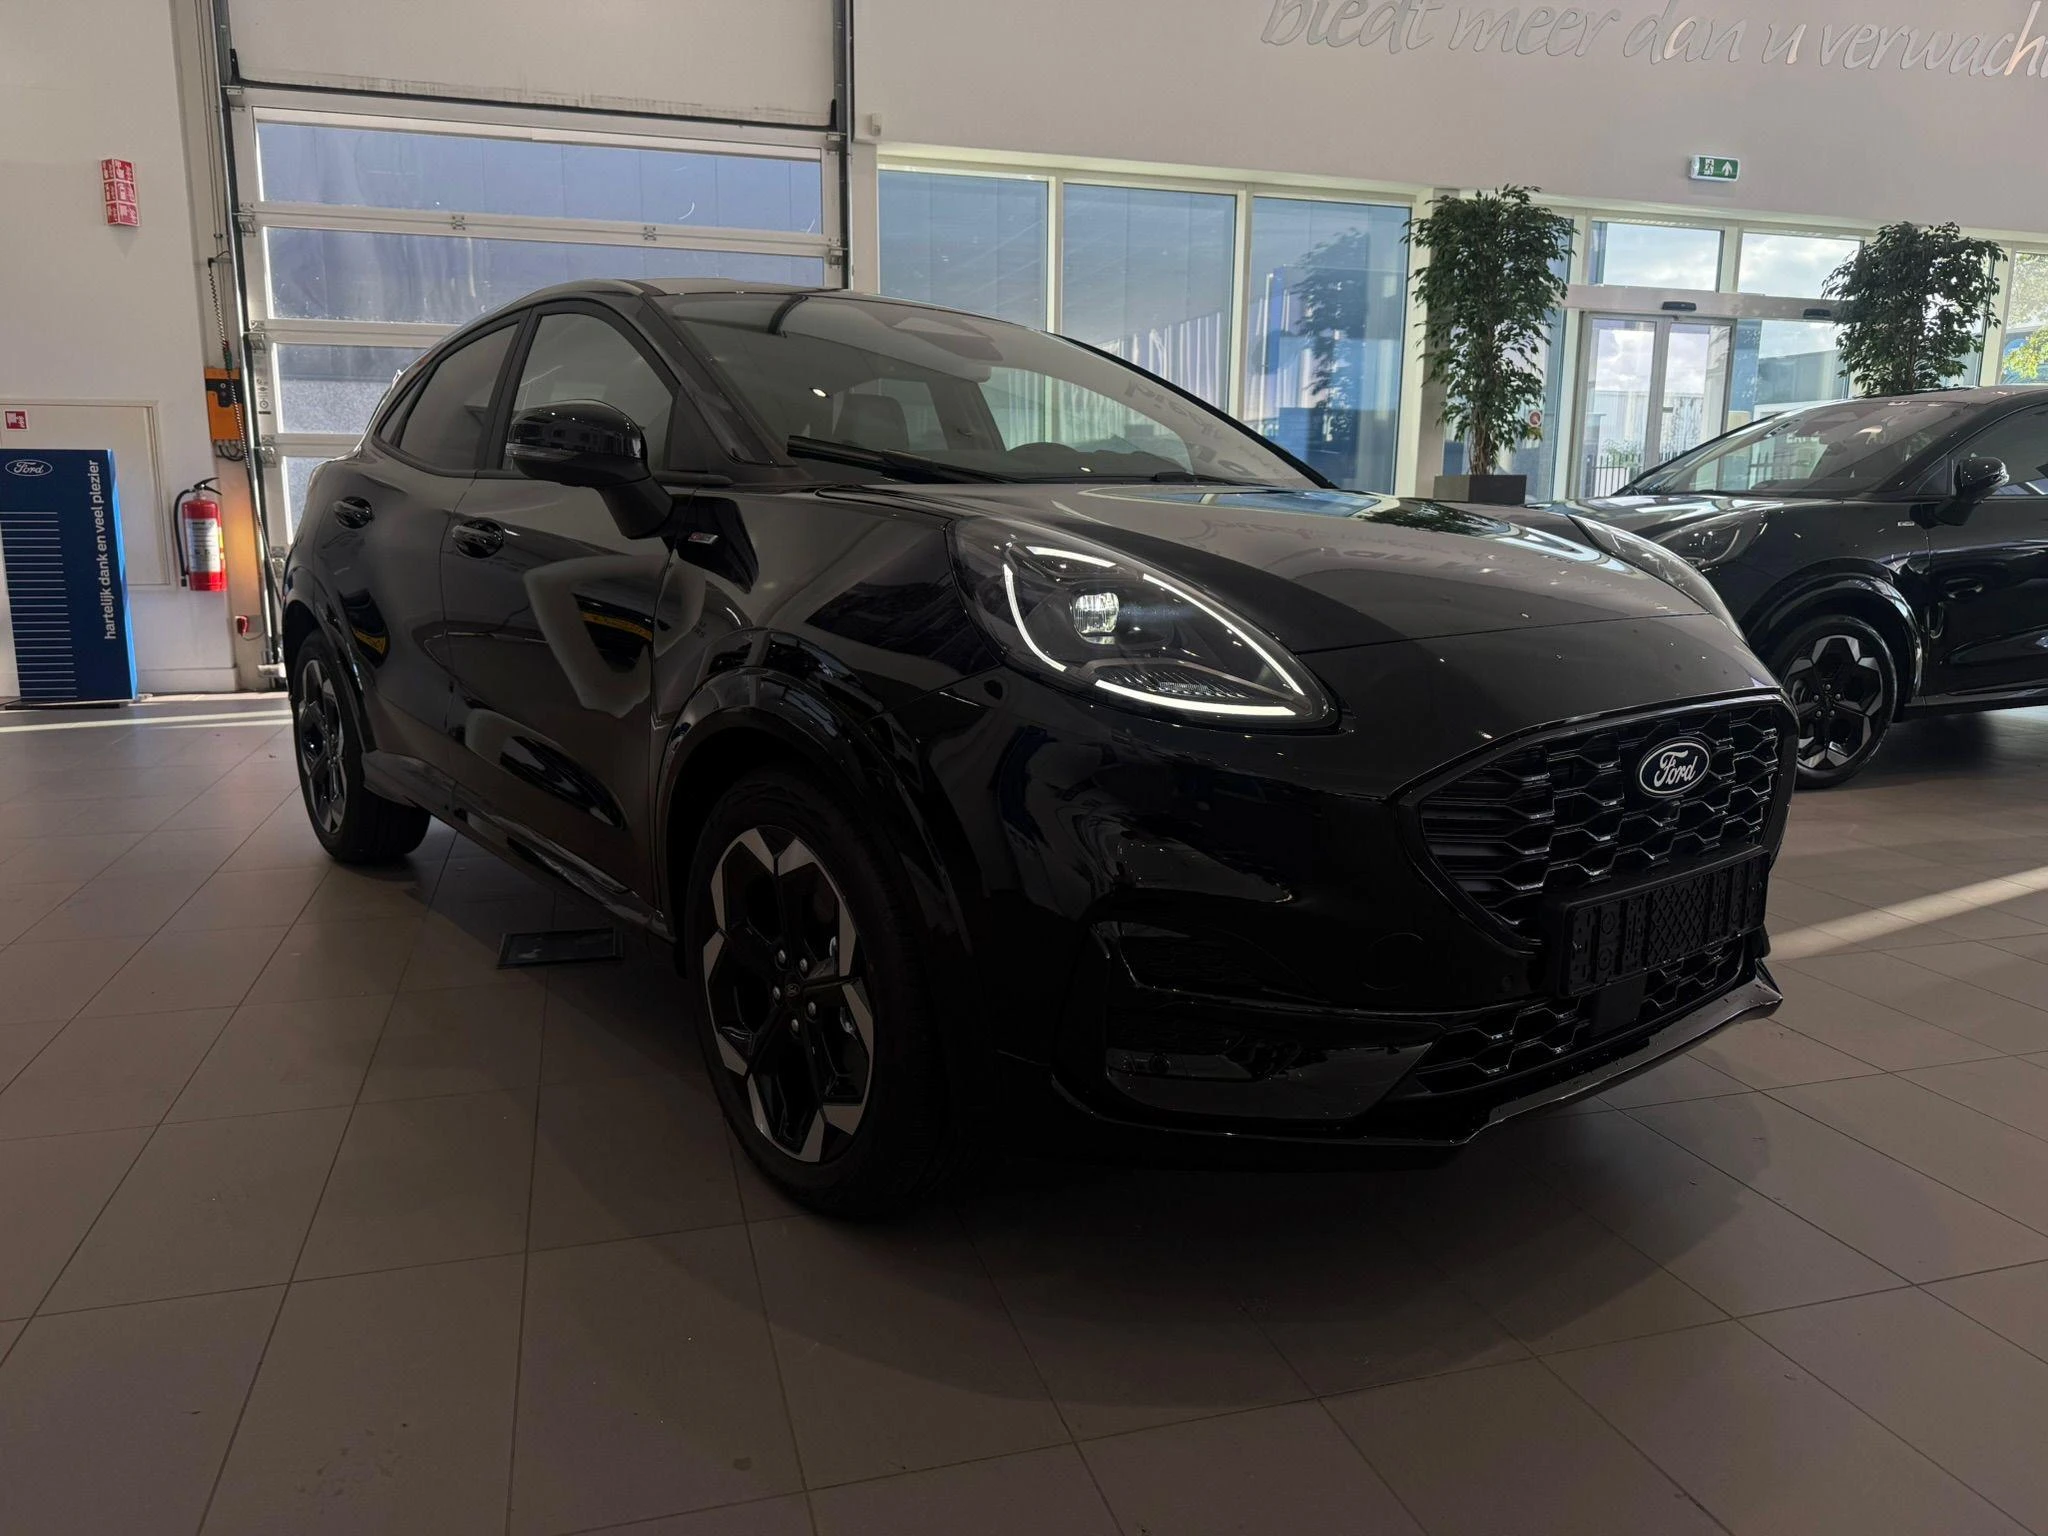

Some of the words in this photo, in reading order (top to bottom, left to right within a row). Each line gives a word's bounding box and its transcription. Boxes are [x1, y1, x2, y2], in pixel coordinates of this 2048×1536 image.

[1447, 6, 1622, 58] meer
[1622, 0, 1748, 66] dan
[1760, 22, 1808, 65] u
[88, 460, 104, 504] plezier
[90, 506, 105, 533] veel
[96, 534, 107, 552] en
[96, 553, 111, 586] dank
[101, 587, 117, 640] hartelijk
[1653, 750, 1698, 787] Ford
